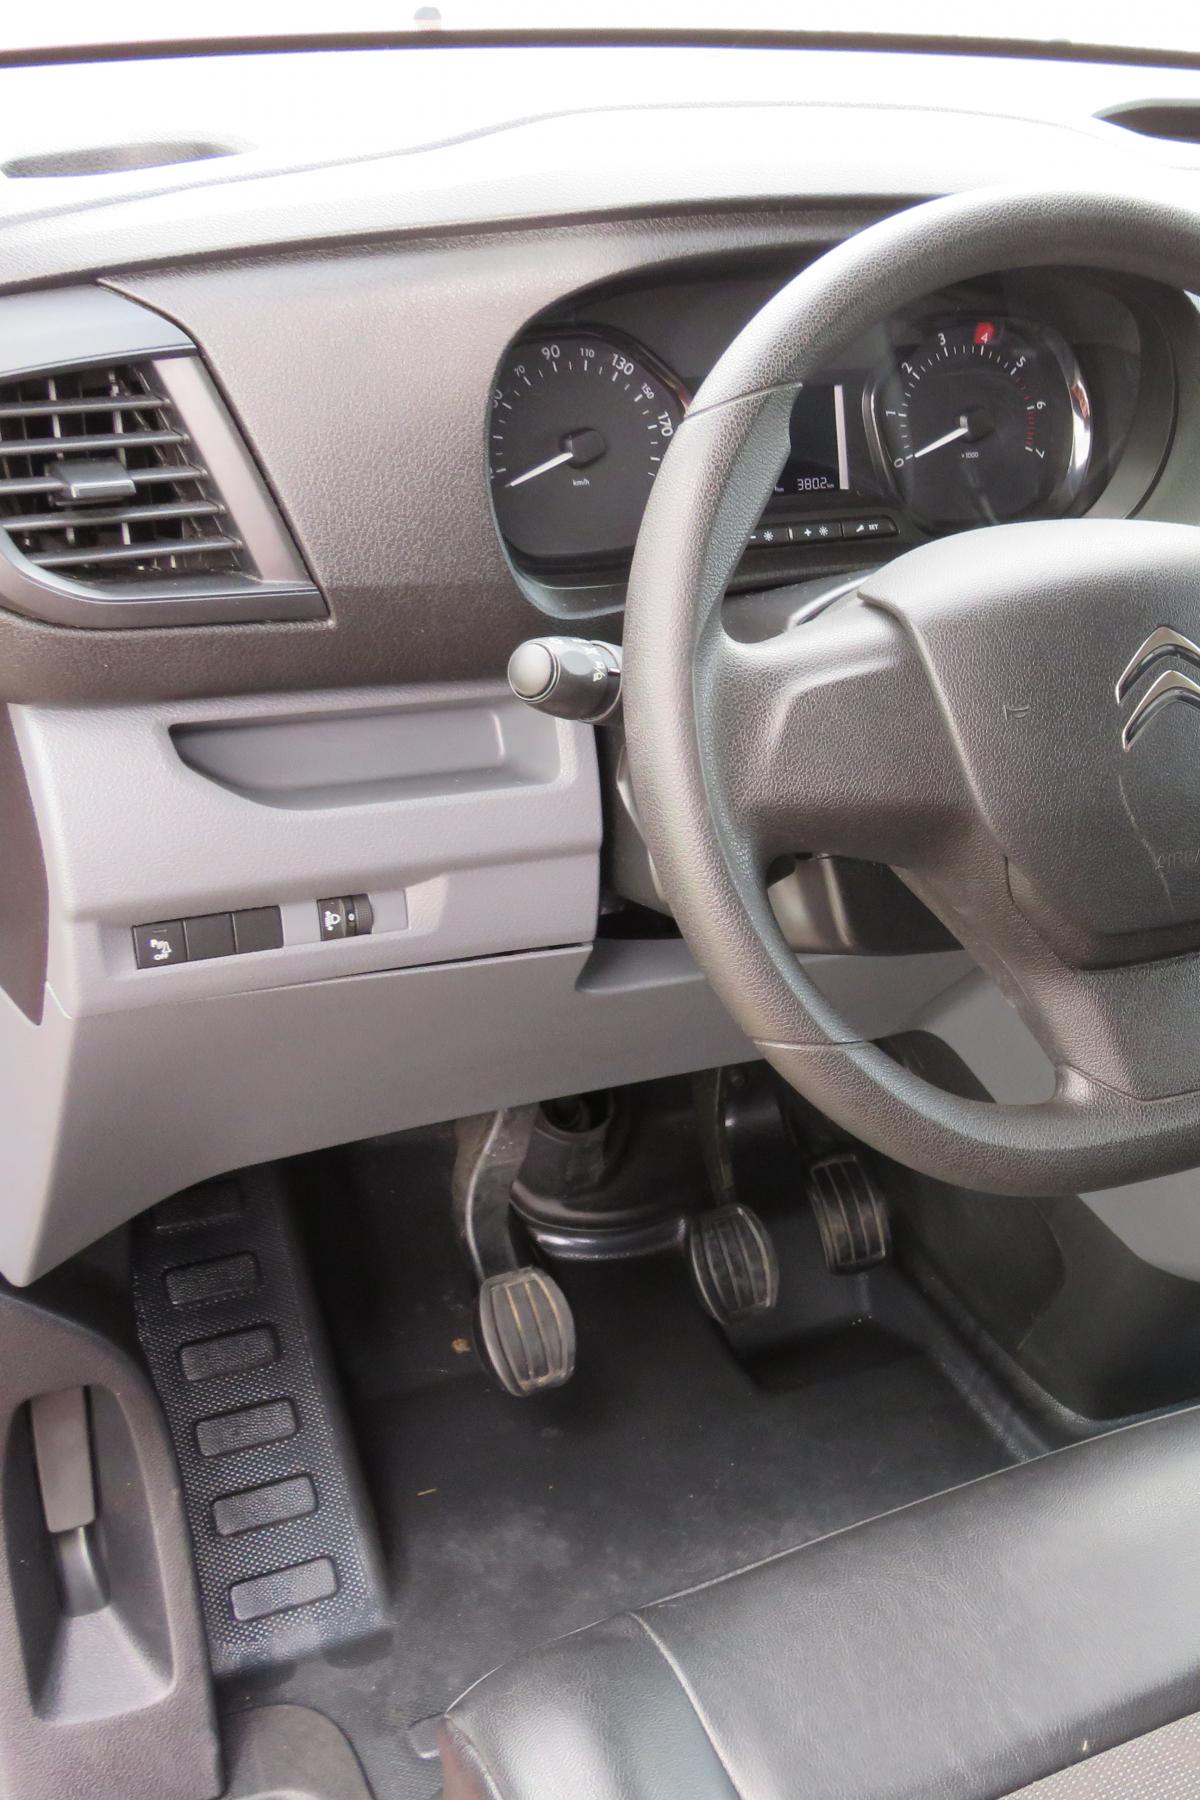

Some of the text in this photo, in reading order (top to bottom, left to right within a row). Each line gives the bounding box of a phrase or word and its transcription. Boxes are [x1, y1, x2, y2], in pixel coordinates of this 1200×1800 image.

[937, 332, 946, 346] 3
[980, 332, 989, 344] 4
[541, 344, 561, 360] 90
[579, 347, 595, 359] 110
[611, 353, 635, 376] 130
[901, 361, 913, 374] 2
[1016, 356, 1027, 368] 5
[513, 364, 526, 376] 70
[640, 382, 655, 400] 150
[1036, 400, 1046, 410] 6
[885, 409, 897, 417] 1
[657, 410, 674, 437] 170
[1035, 448, 1046, 459] 7
[893, 457, 905, 468] 0
